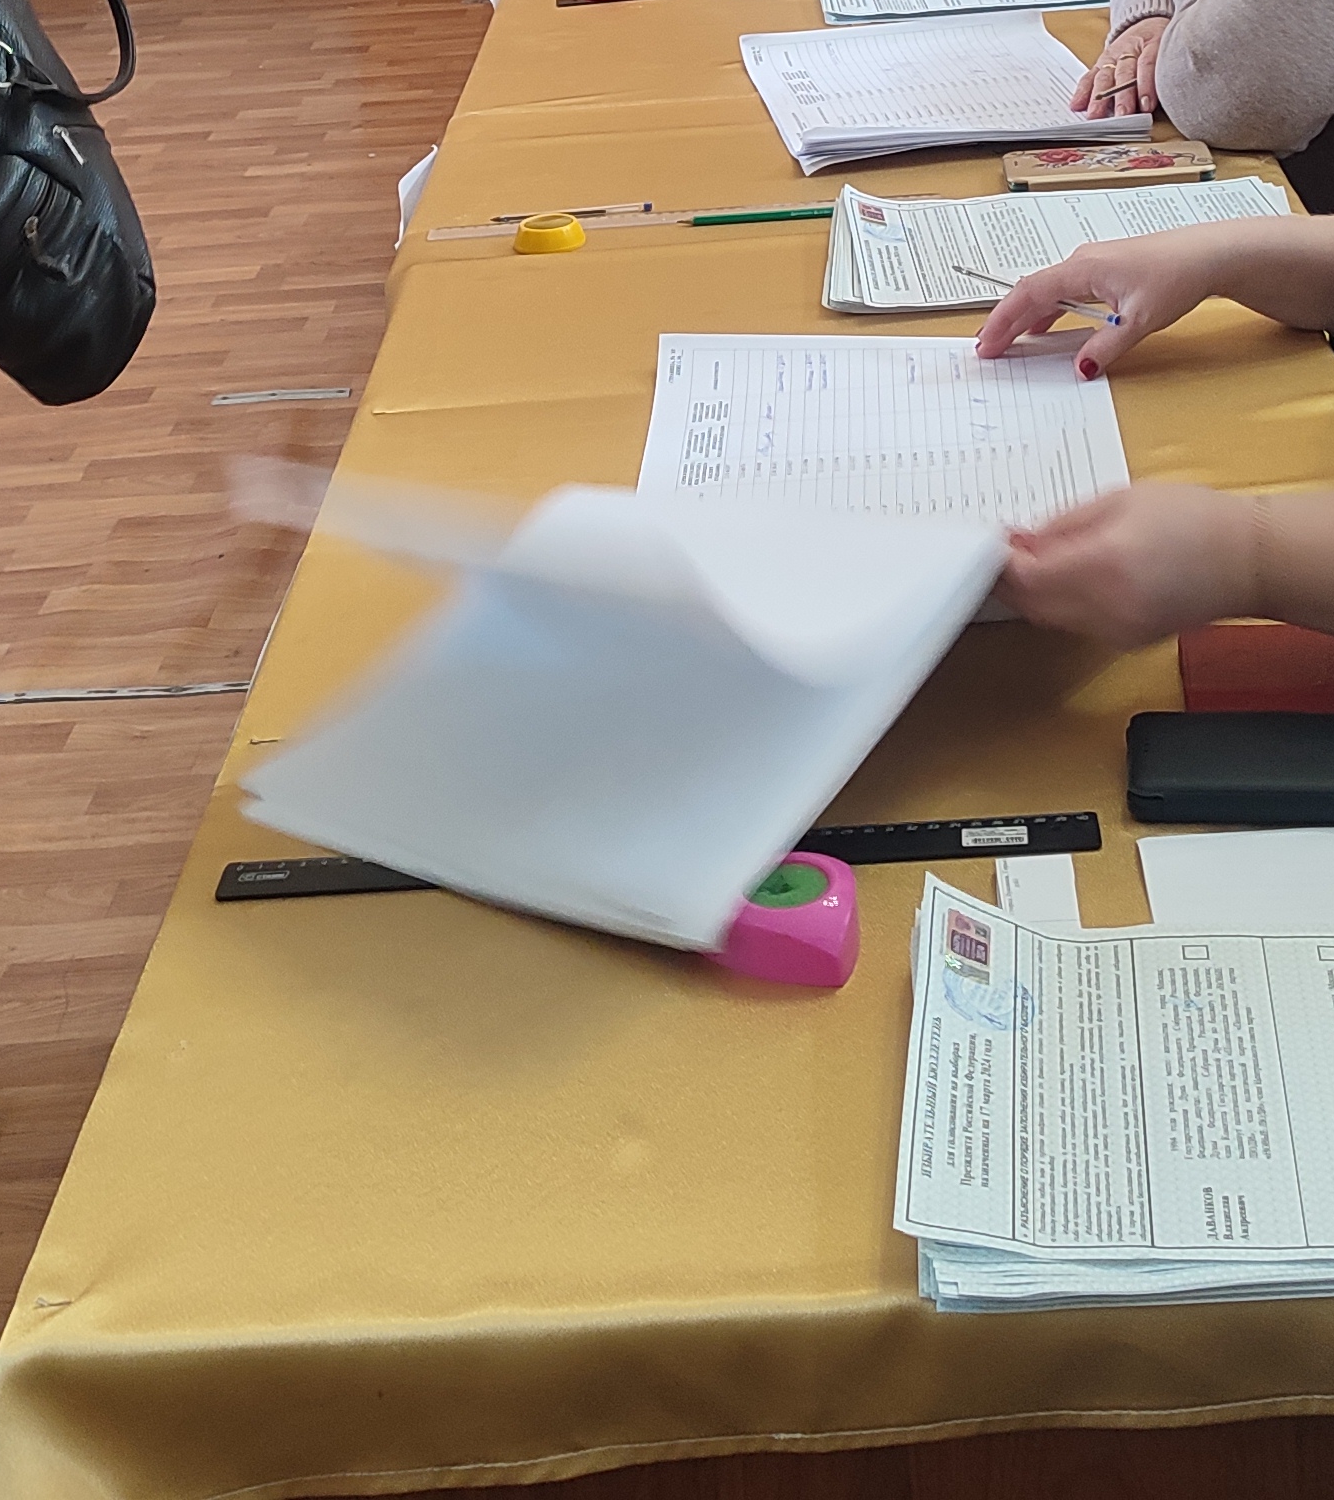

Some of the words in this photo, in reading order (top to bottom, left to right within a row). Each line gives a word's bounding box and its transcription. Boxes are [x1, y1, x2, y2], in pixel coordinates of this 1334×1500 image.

[926, 1017, 942, 1081] БЮЛЛЕТЕНЬ
[980, 1059, 991, 1078] 2024
[920, 1082, 939, 1179] ИЗБИРАТЕЛЬНЫЙ
[961, 1083, 975, 1133] Российской
[980, 1107, 989, 1117] 17
[961, 1136, 975, 1186] Президента
[1203, 1186, 1219, 1240] ДАВАНКОВ
[1220, 1196, 1233, 1240] Владислав
[1236, 1195, 1250, 1240] Андреевич
